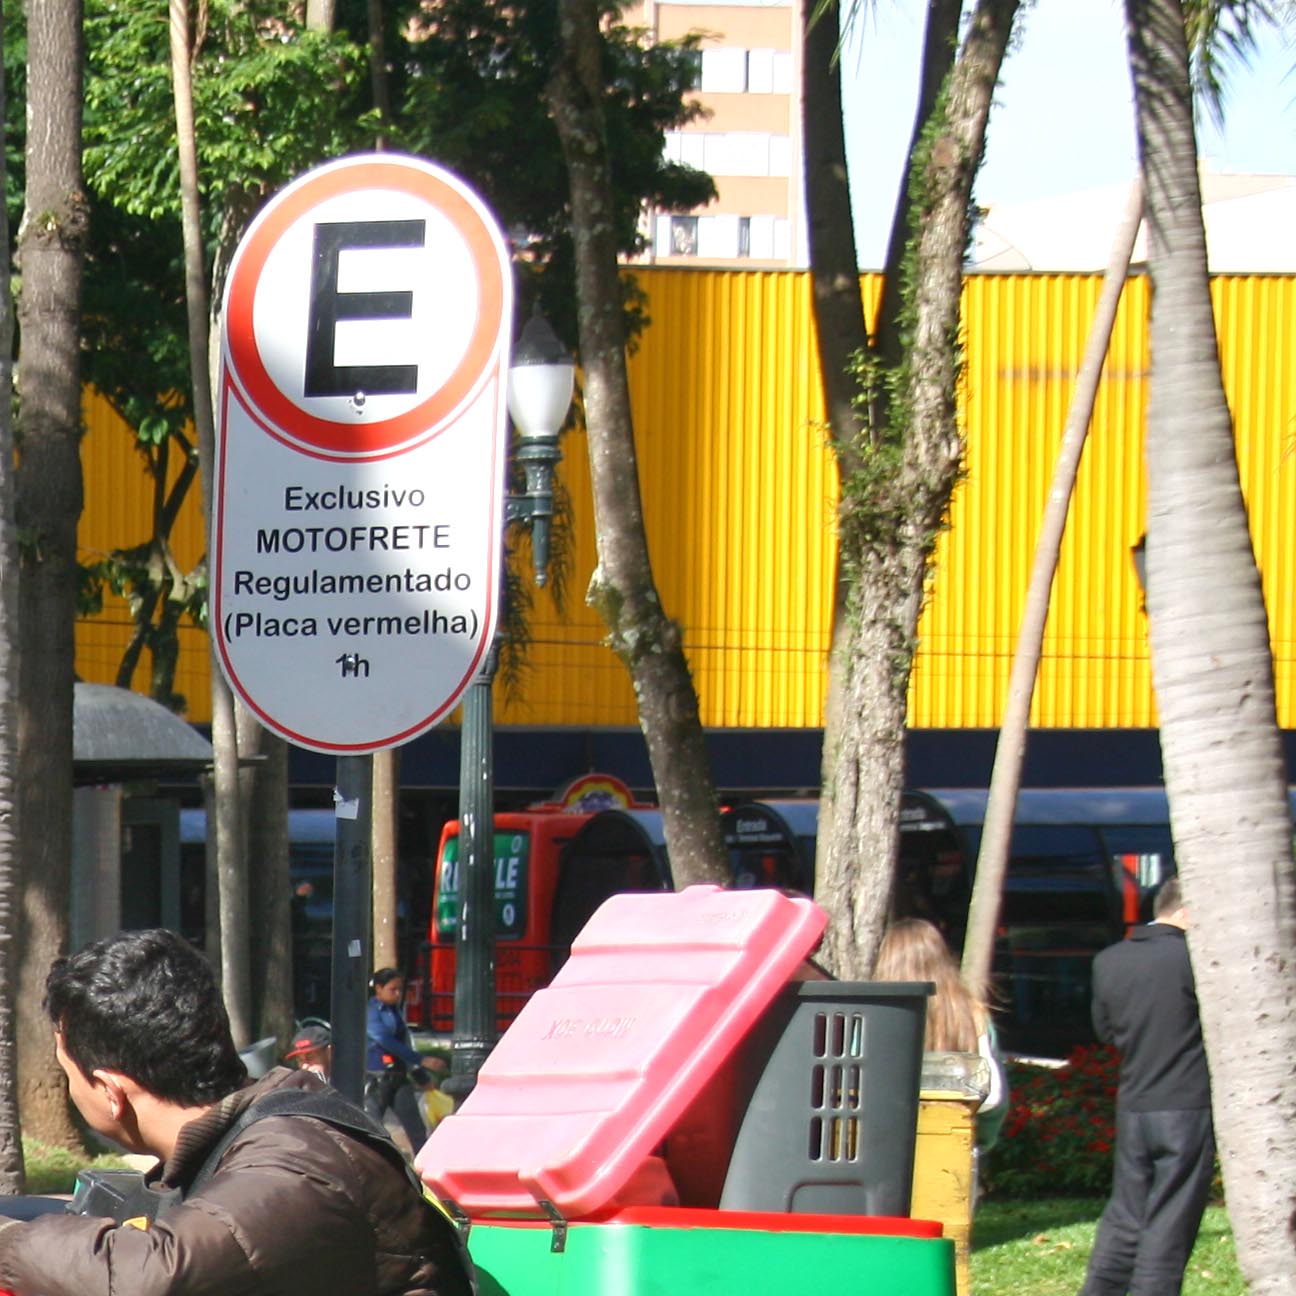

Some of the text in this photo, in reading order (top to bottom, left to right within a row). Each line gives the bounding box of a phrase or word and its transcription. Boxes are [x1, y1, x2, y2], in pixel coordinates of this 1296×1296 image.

[304, 219, 426, 398] E
[284, 483, 425, 512] Exclusivo
[257, 525, 451, 554] MOTOFRETE
[234, 569, 472, 600] Regulamentado
[224, 608, 479, 641] (Placa vermelha)
[336, 653, 370, 679] 1h
